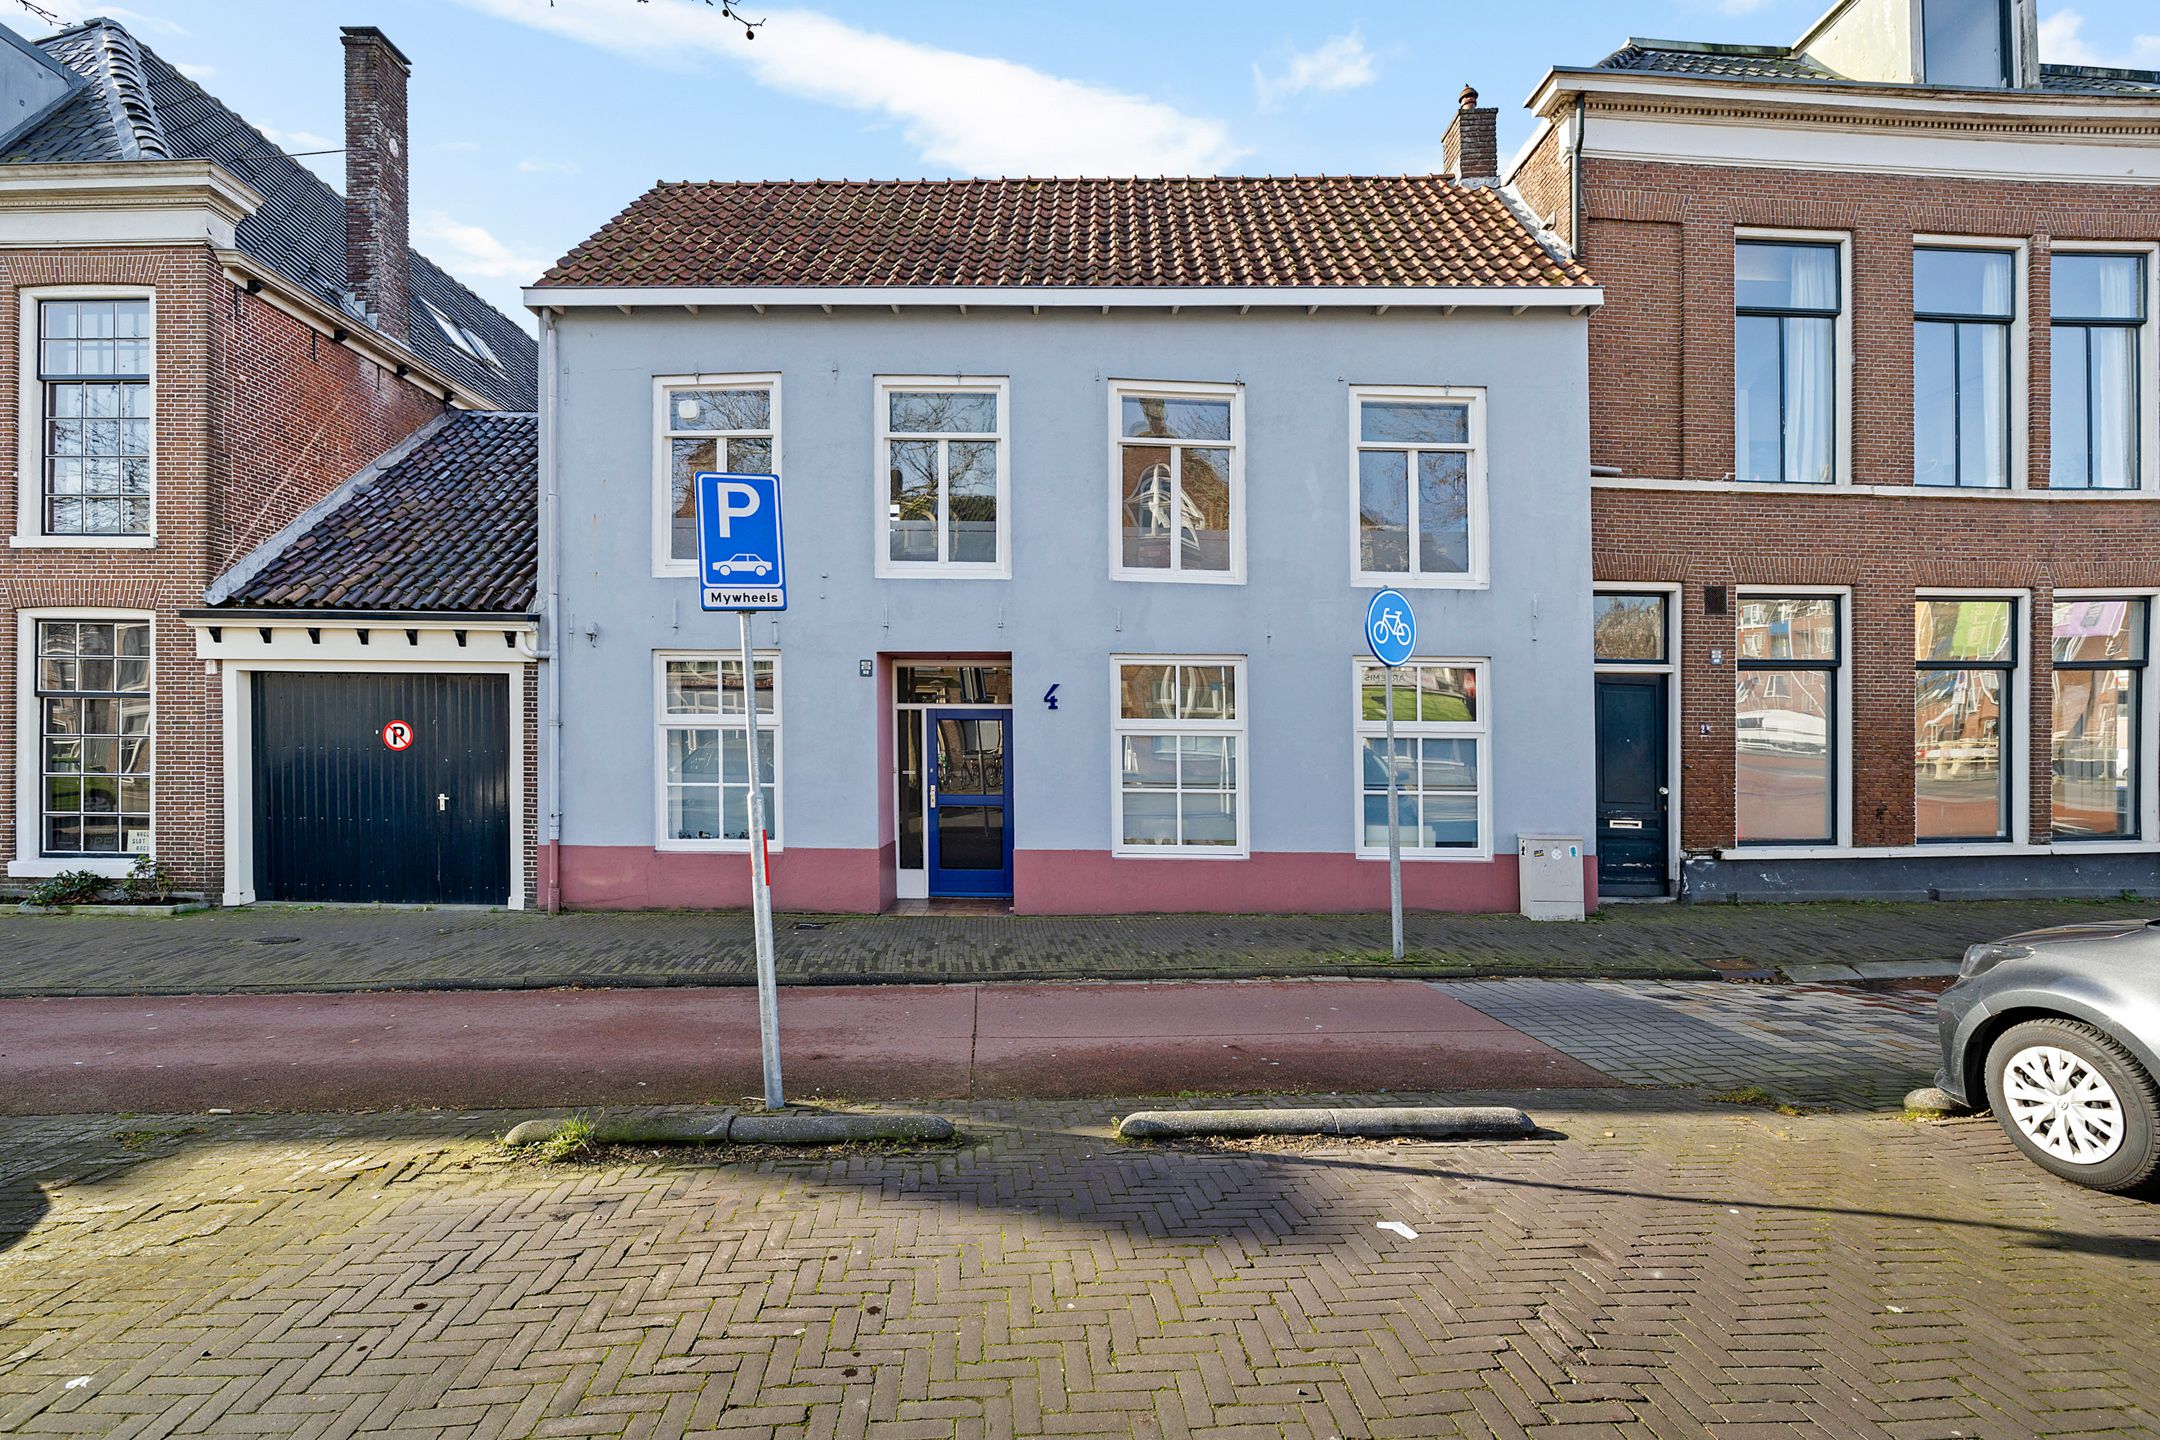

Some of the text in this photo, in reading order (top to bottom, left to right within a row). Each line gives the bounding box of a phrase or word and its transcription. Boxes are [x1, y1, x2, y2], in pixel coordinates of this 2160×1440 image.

[717, 482, 760, 538] P
[711, 592, 778, 605] Mywheels
[1044, 683, 1060, 710] 4
[393, 726, 405, 745] P
